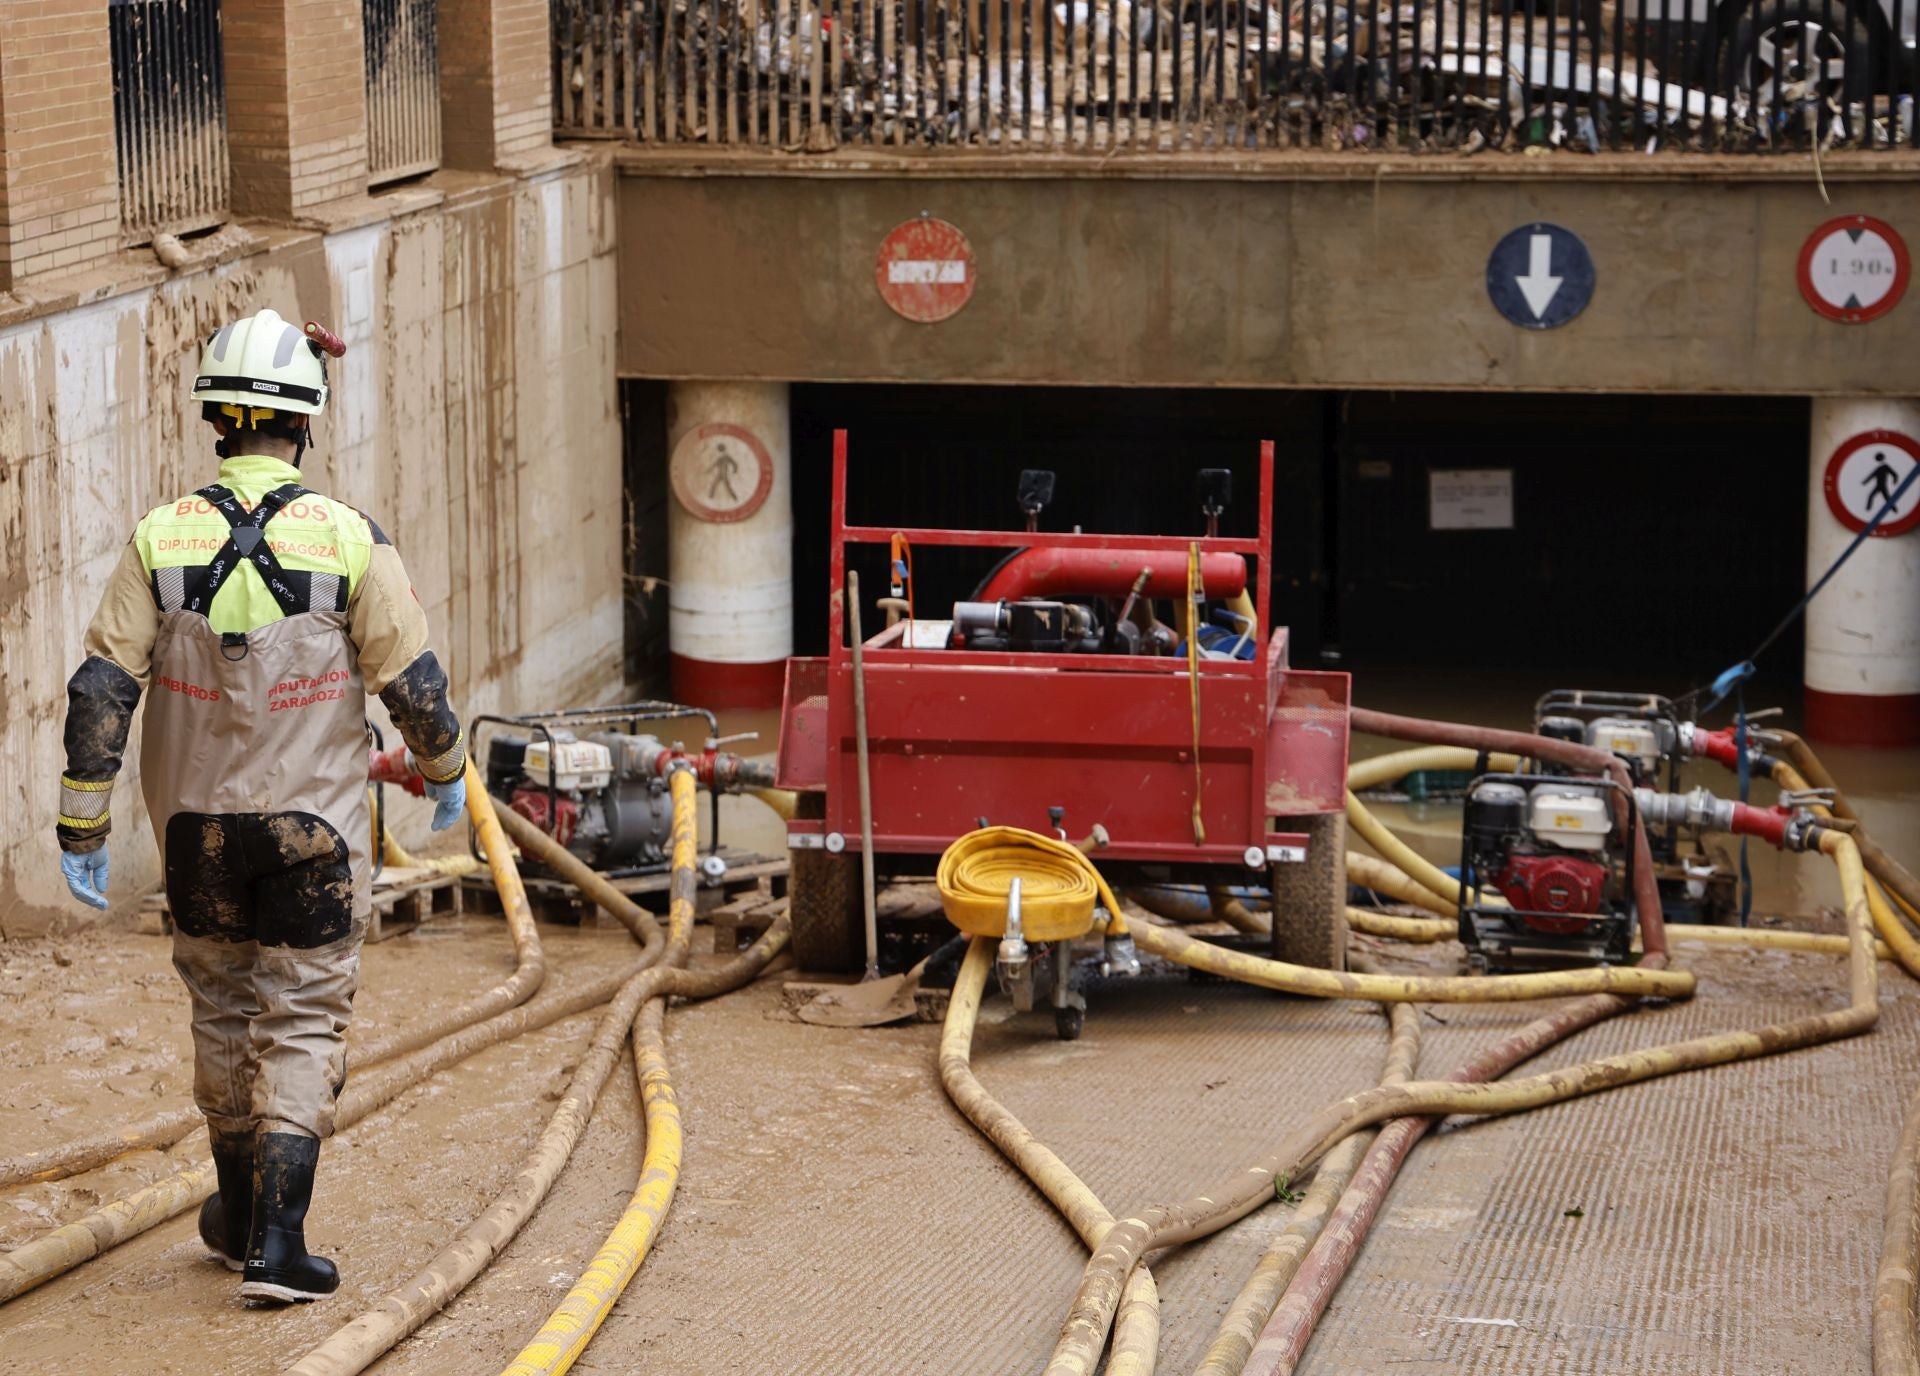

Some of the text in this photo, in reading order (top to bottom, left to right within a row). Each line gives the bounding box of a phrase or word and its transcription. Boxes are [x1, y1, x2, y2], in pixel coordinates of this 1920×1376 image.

[252, 382, 279, 392] MSA
[158, 538, 337, 558] DIPUTACI ARAGOZA
[267, 669, 349, 699] DIPUTACIÓN
[269, 688, 345, 713] ZARAGOZA
